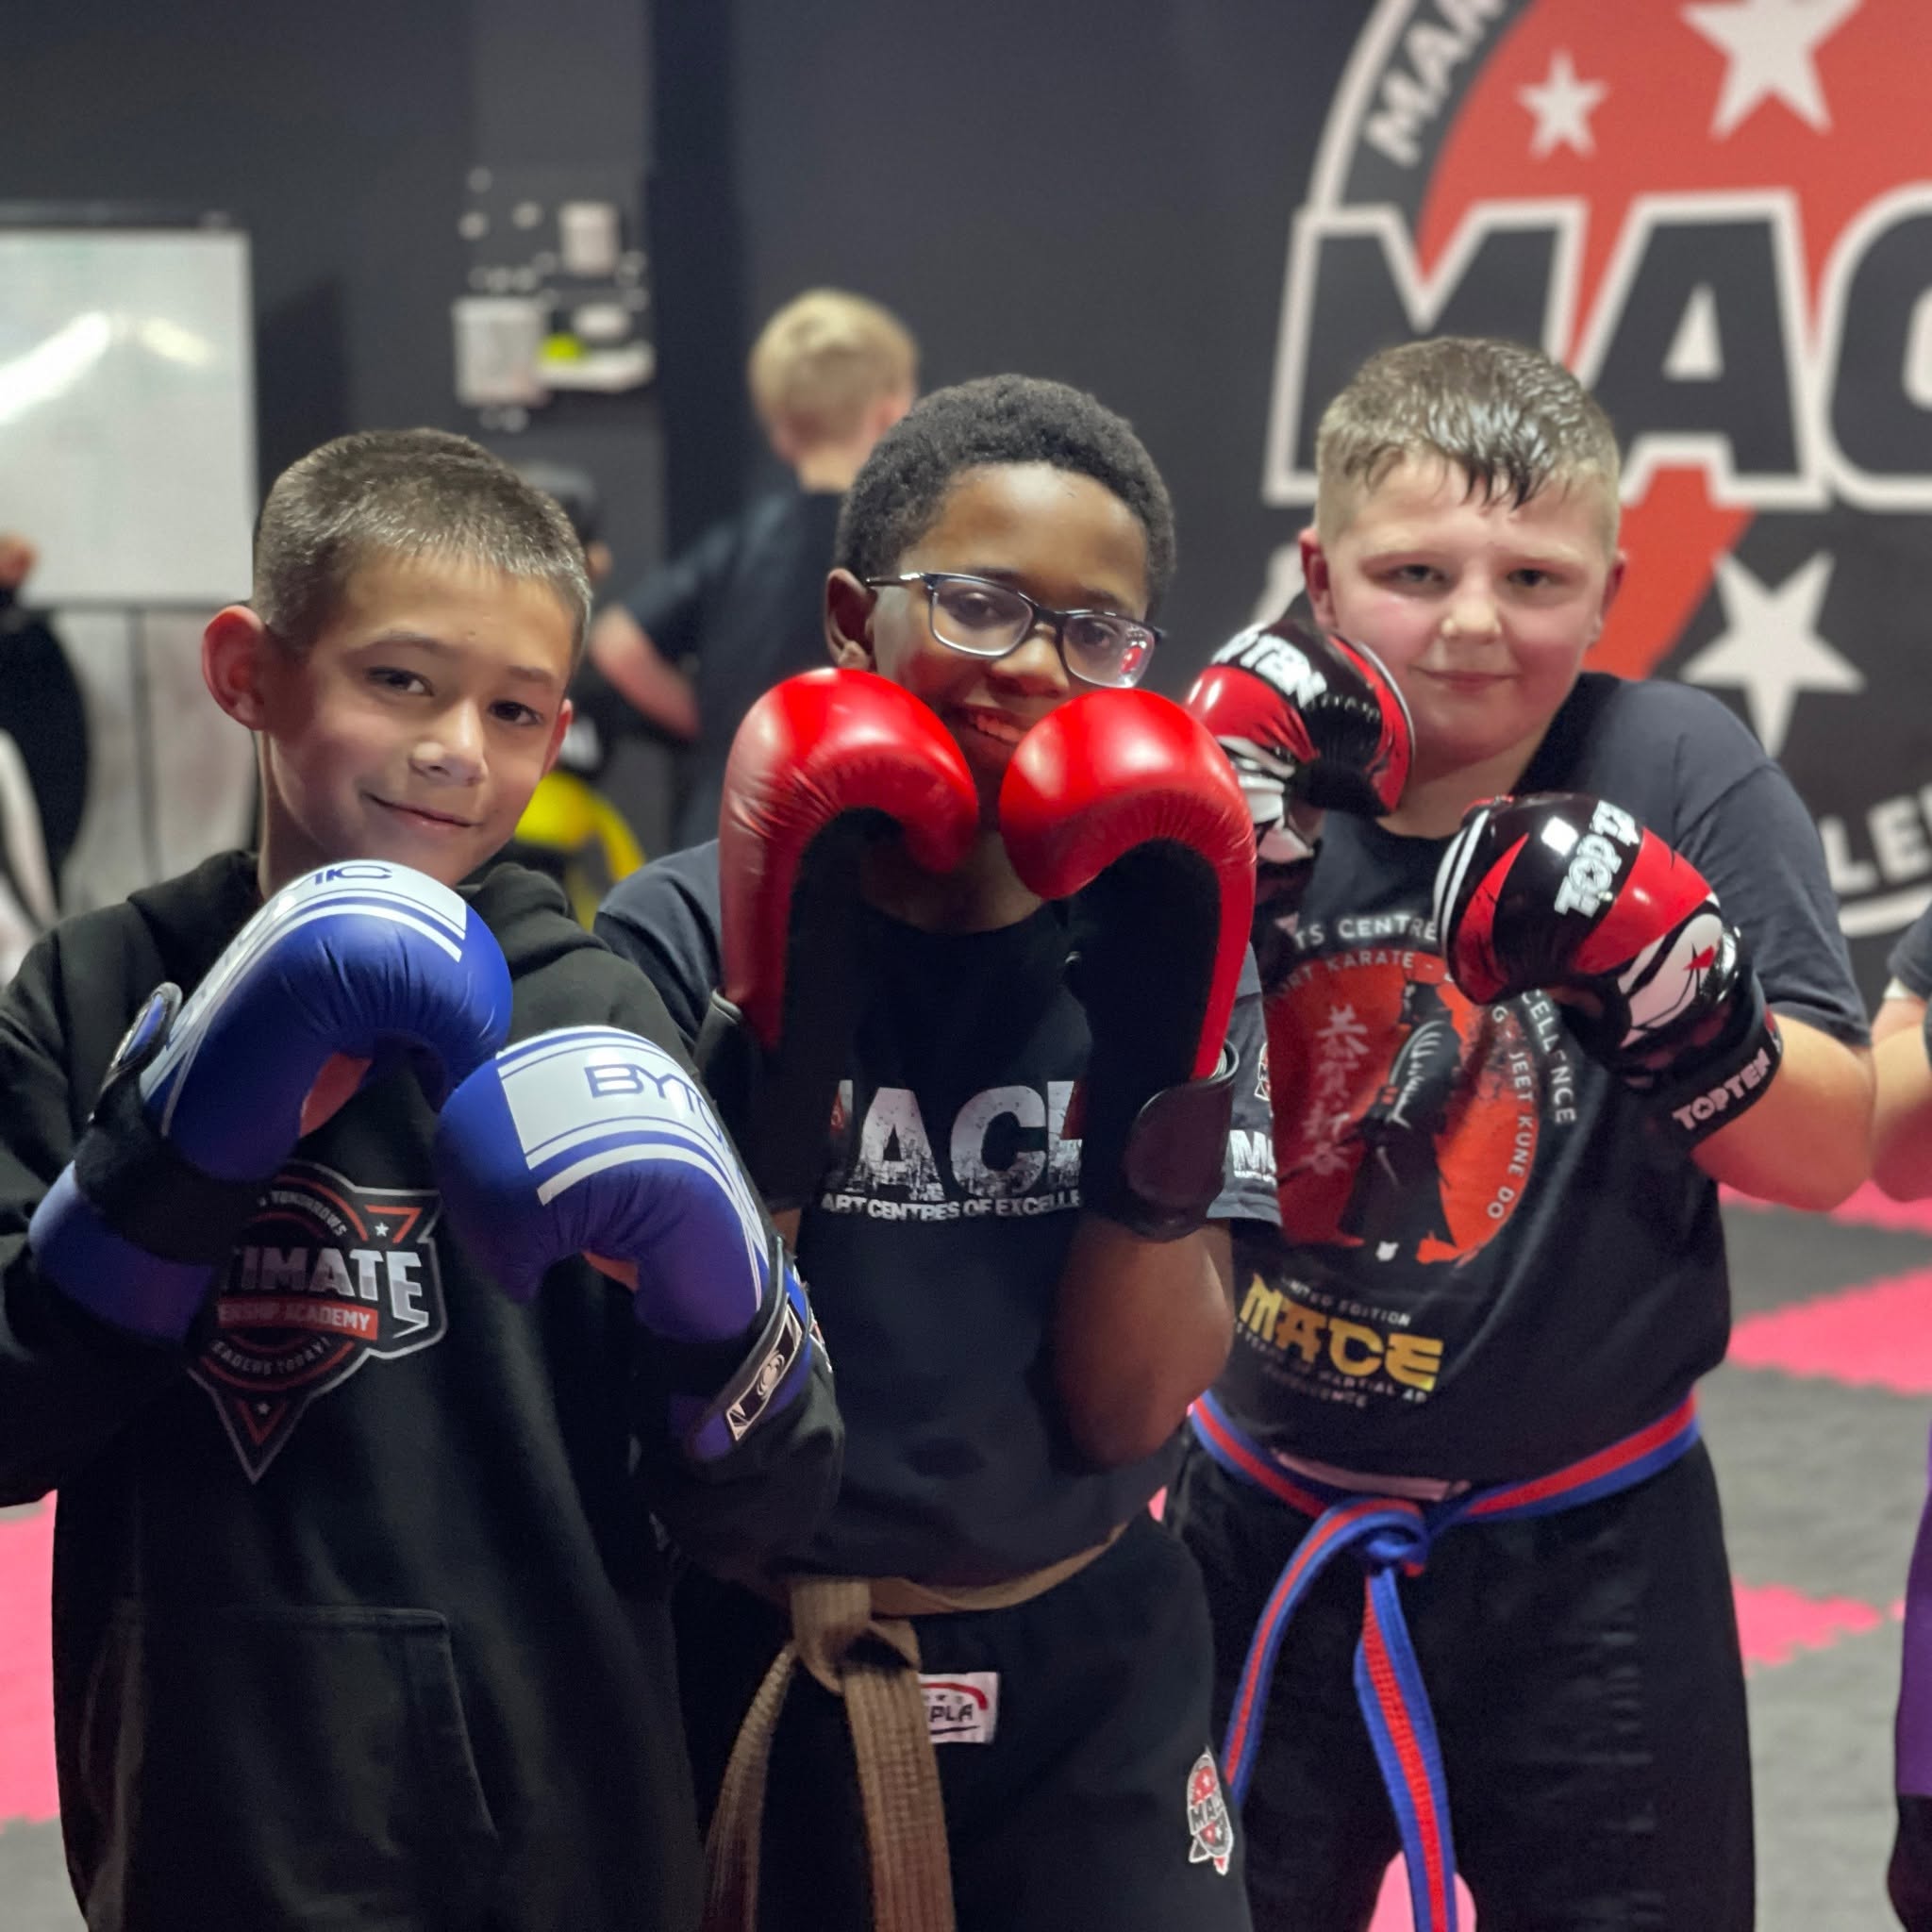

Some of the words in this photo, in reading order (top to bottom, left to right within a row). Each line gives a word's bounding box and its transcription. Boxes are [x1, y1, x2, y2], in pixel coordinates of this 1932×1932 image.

[1325, 949, 1415, 974] KARATE
[1510, 1051, 1534, 1102] JEET
[1507, 1115, 1534, 1177] KUNE
[867, 1199, 960, 1222] CENTRES
[962, 1198, 992, 1218] OF
[1486, 1184, 1515, 1220] DO
[1239, 1272, 1444, 1392] MACE
